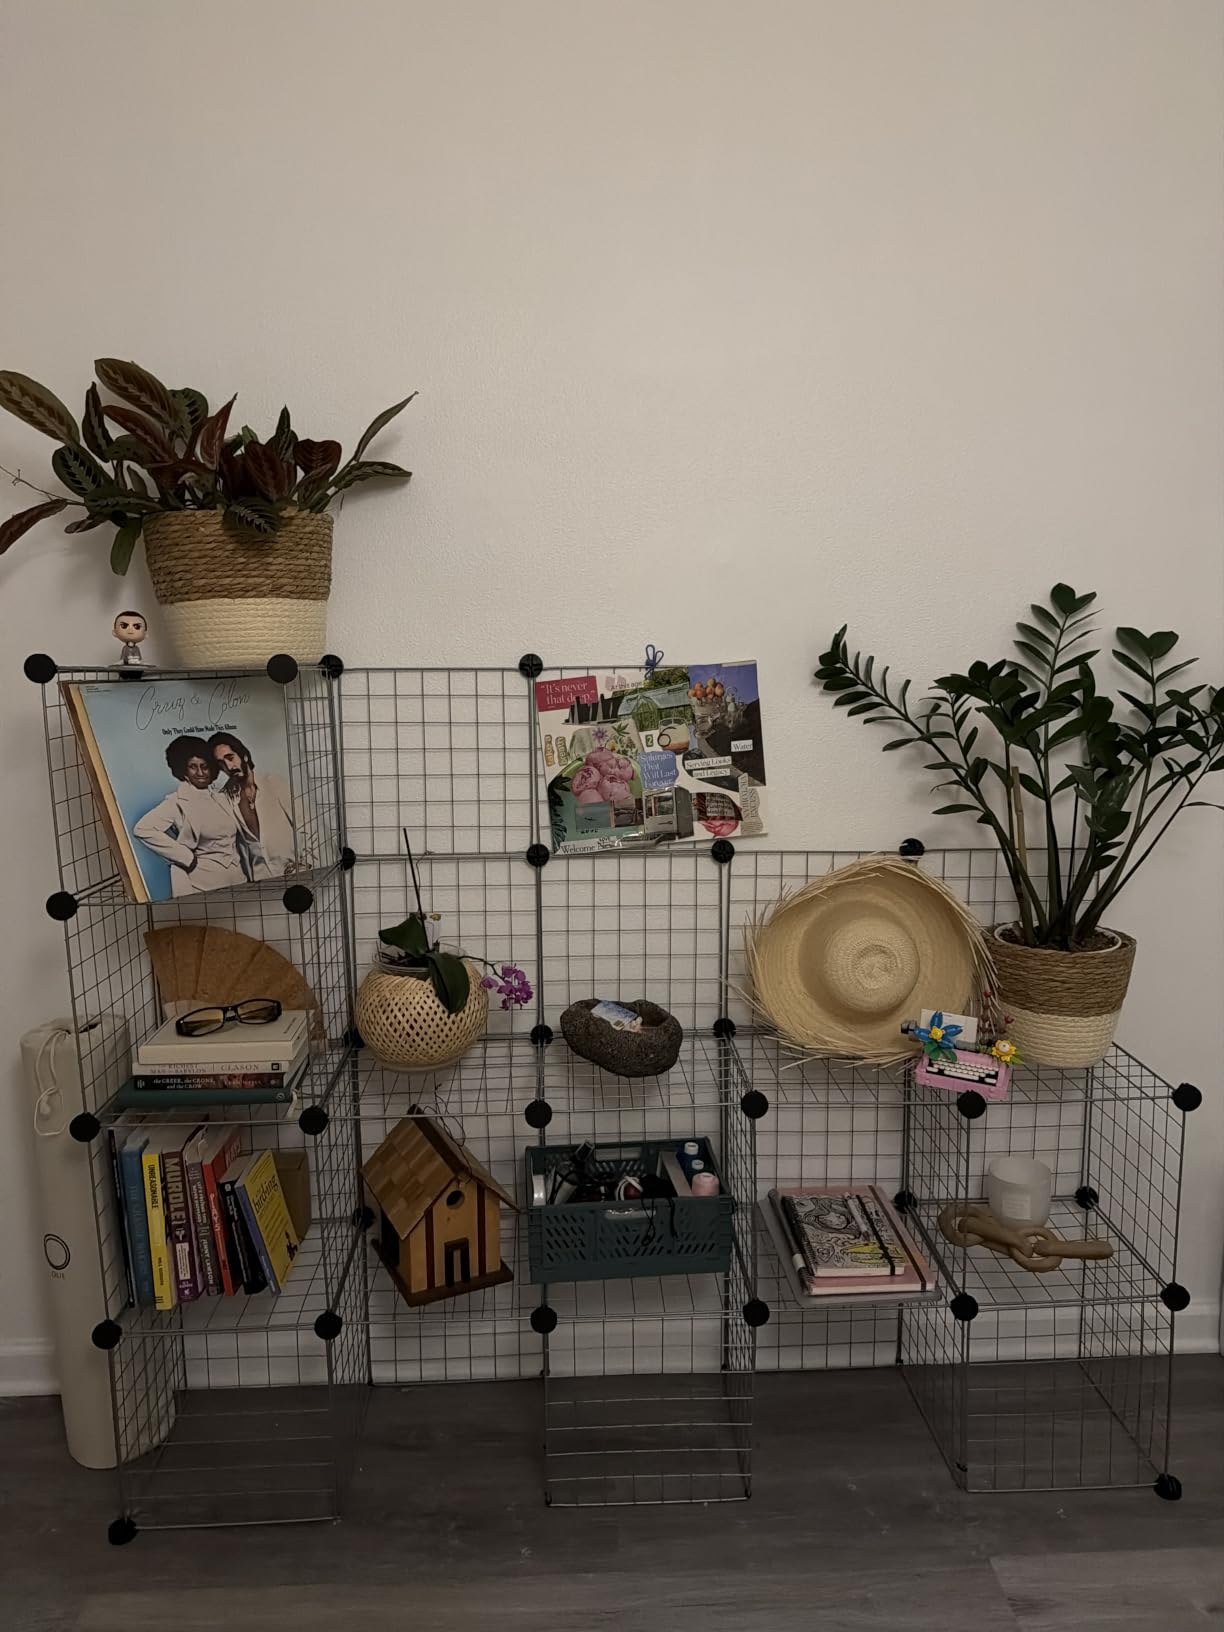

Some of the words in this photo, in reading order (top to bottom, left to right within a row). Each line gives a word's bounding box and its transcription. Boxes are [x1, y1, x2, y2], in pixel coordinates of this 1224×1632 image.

[561, 682, 587, 692] never
[546, 694, 565, 704] that
[561, 844, 595, 853] Welcome
[221, 1062, 259, 1072] CLASON
[165, 1158, 186, 1220] MURDLE
[205, 1259, 213, 1285] LAWSON
